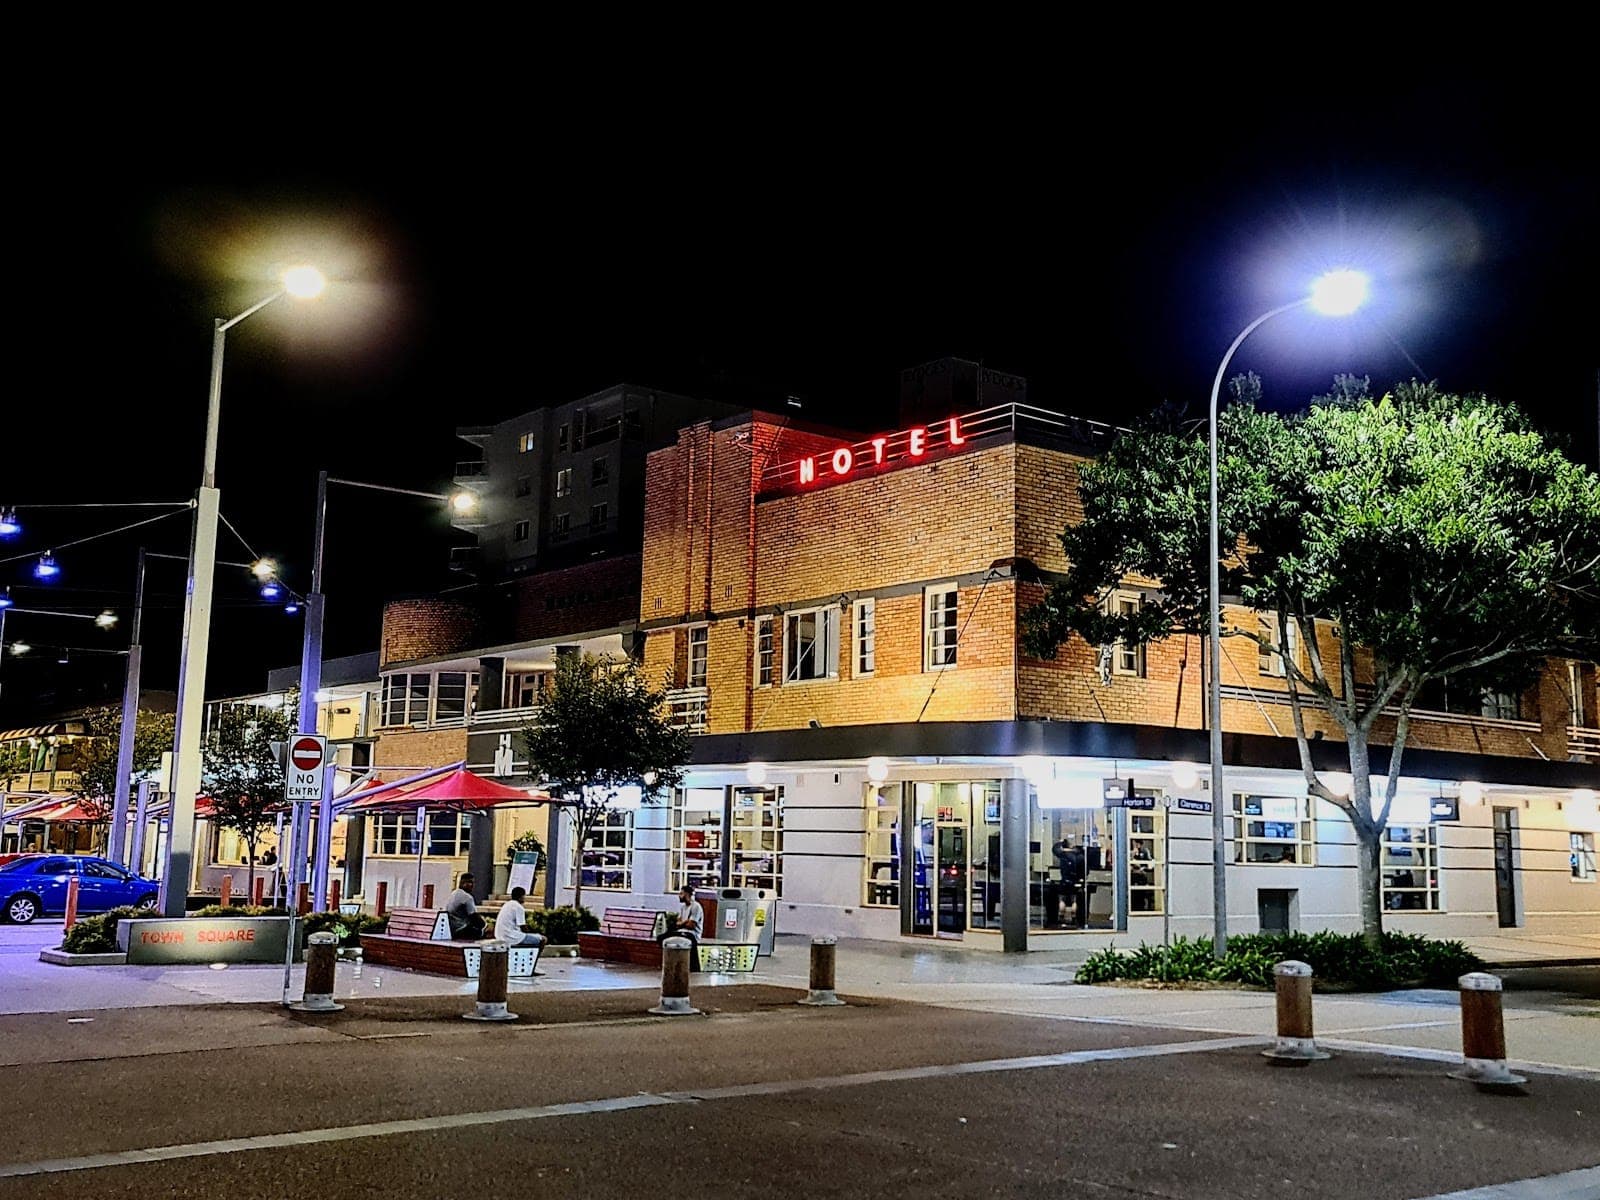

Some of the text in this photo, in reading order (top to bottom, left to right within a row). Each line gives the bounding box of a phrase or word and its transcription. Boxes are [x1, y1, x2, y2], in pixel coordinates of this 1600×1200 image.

[799, 417, 965, 485] HOTEL
[296, 774, 314, 784] NO
[289, 787, 319, 795] ENTRY
[1145, 798, 1152, 806] St
[1180, 799, 1203, 810] Clarence
[140, 928, 256, 944] TOWN SQUARE
